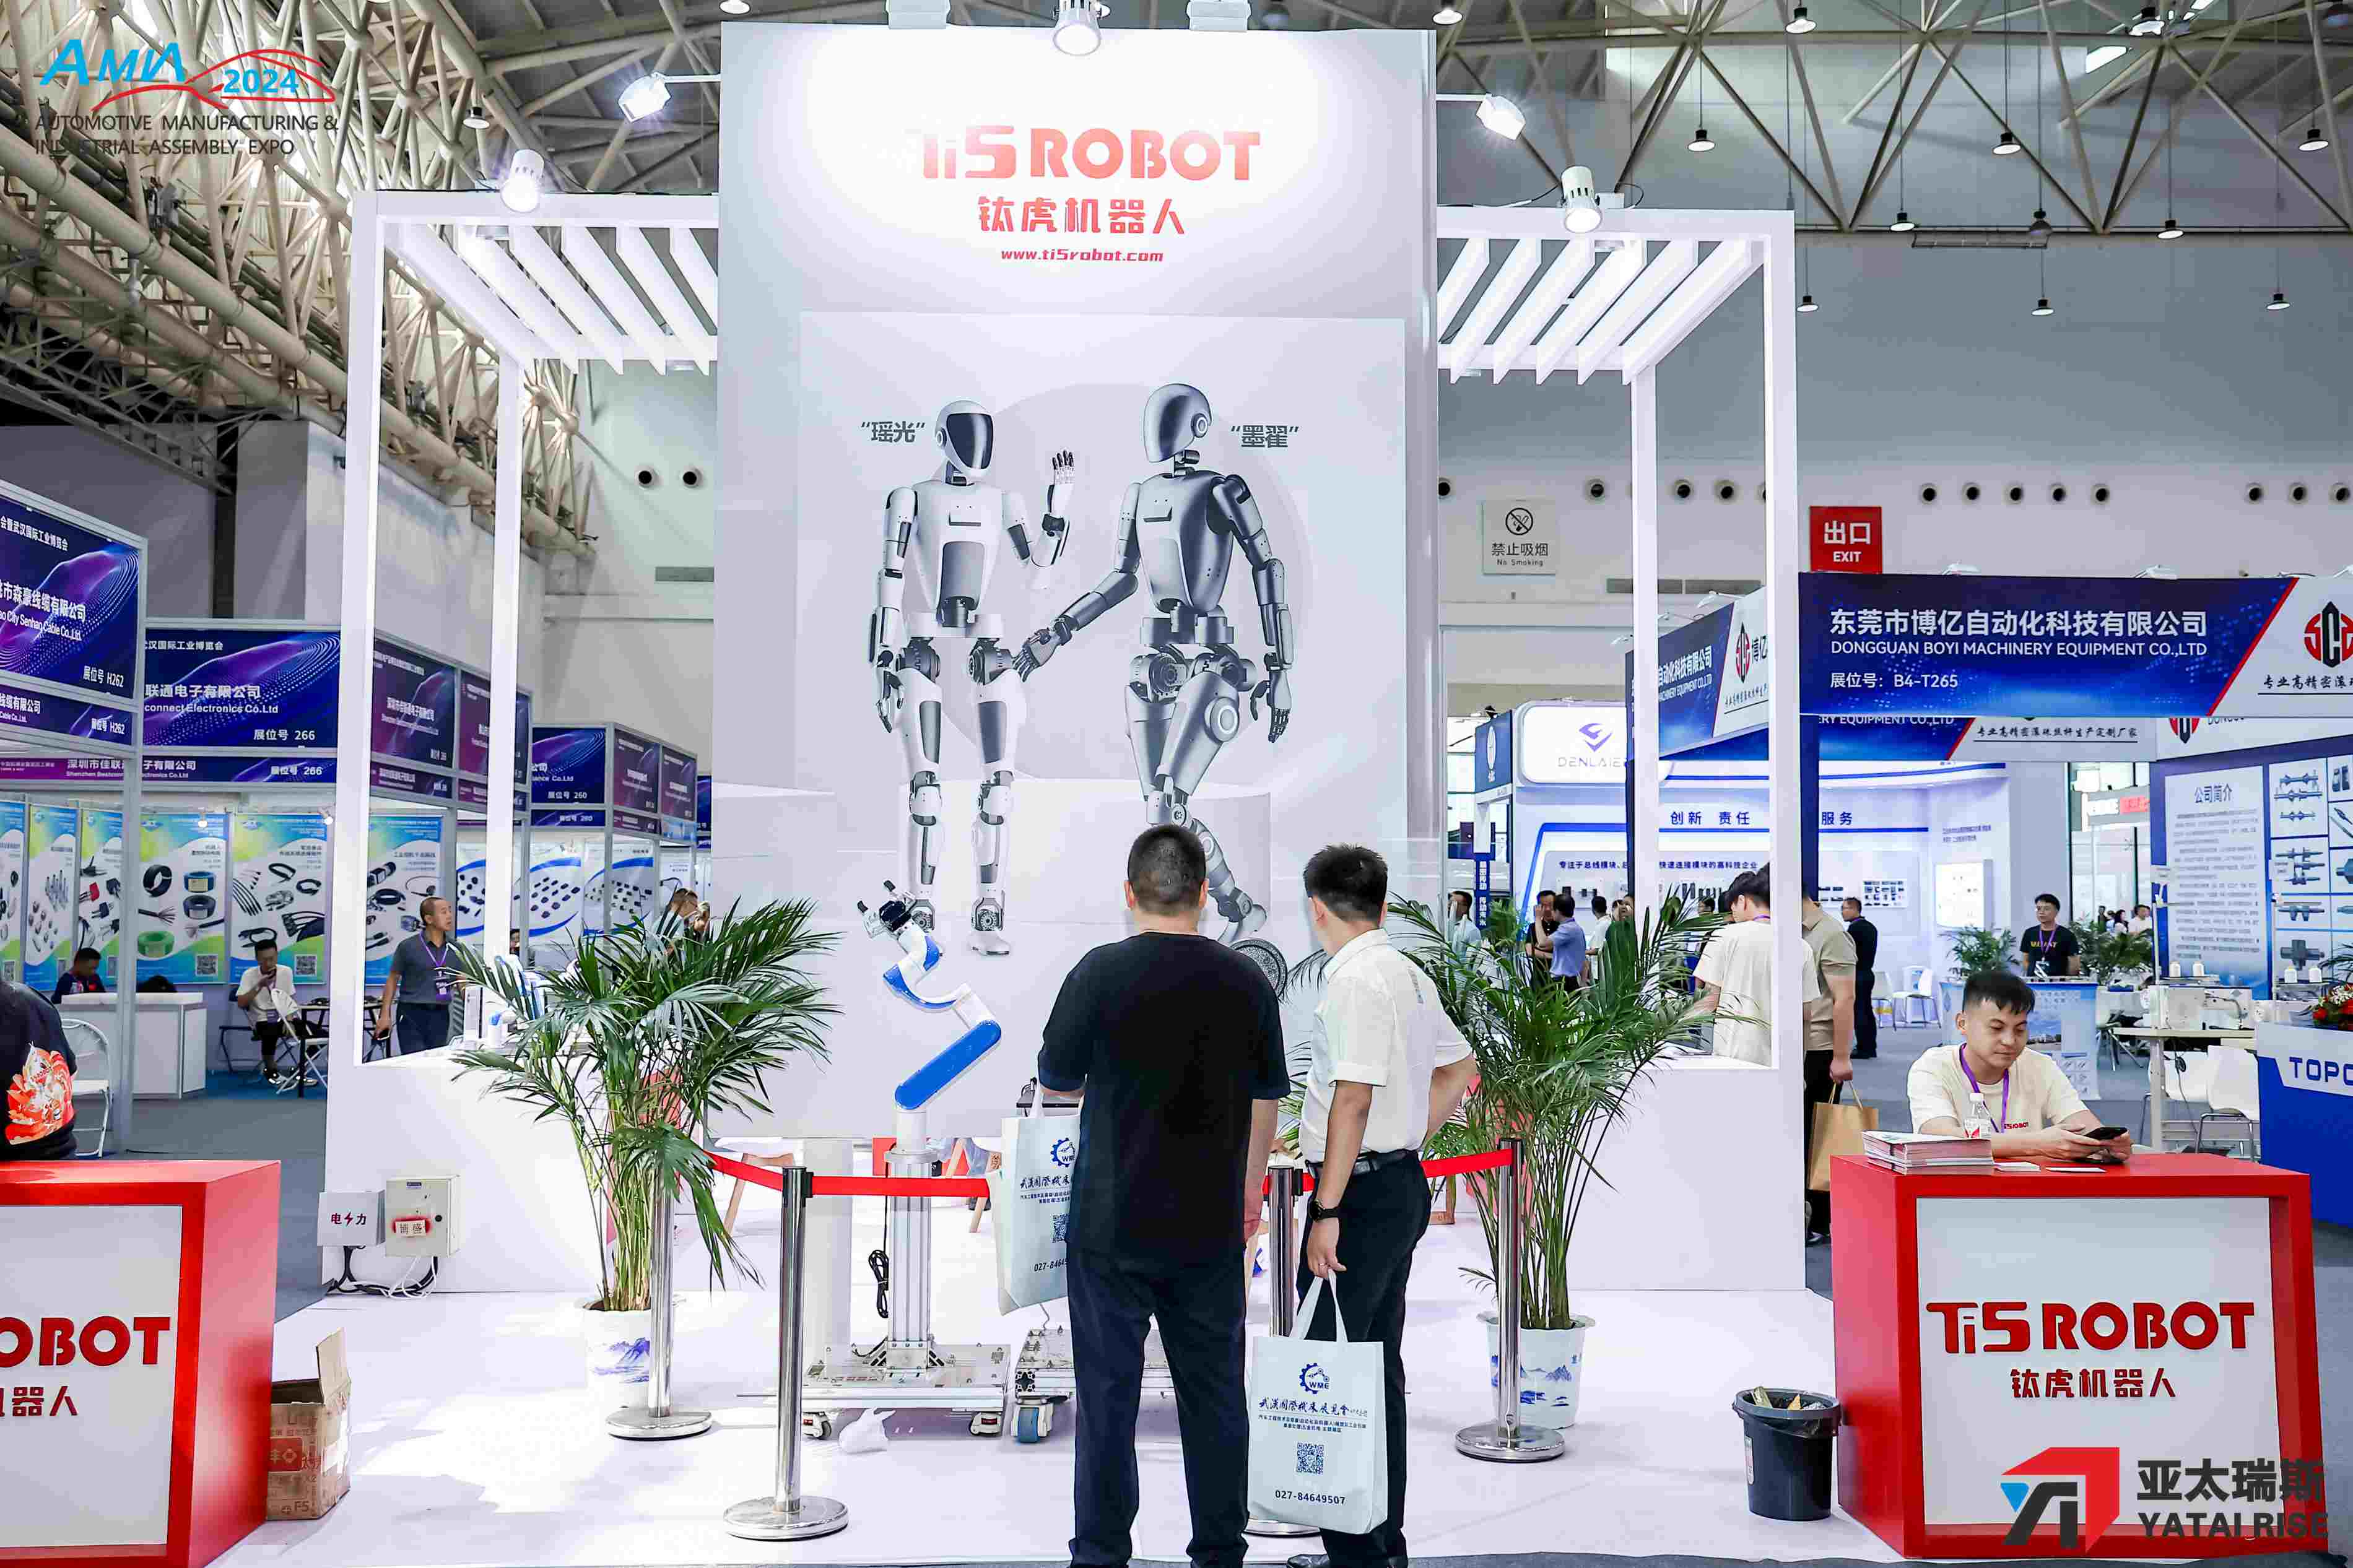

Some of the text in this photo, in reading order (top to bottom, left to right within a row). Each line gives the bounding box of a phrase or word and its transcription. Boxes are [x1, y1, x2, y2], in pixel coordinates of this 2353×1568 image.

[1030, 128, 1260, 181] ROBOT
[978, 196, 1185, 235] 钛虎机器人
[1001, 249, 1164, 262] www.ti5robot.com
[1824, 521, 1871, 545] 出口
[1491, 543, 1549, 557] 禁止吸烟
[1833, 551, 1861, 563] EXIT
[1511, 559, 1544, 567] Smoking
[1830, 609, 2206, 637] 东莞市博亿自动化科技有限公司
[1832, 641, 2207, 657] DONGGUAN BOYI MACHINERY EQUIPMENT CO.,LTD
[84, 665, 124, 688] 展位号 H262
[1894, 674, 1958, 687] B4-T265
[145, 684, 261, 698] 联通电子有限公司
[110, 722, 124, 734] H262
[254, 729, 315, 741] 展位号 266
[1558, 757, 1627, 767] DENLAIE
[303, 767, 323, 775] 266
[2194, 784, 2232, 803] 公司简介
[1671, 812, 1853, 825] 创新 责任 服务
[331, 1213, 367, 1225] 电 力
[2042, 1301, 2255, 1349] ROBOT
[2011, 1367, 2175, 1398] 钛虎机器人
[0, 1386, 78, 1416] 器人
[1275, 1490, 1346, 1504] 027-84649507
